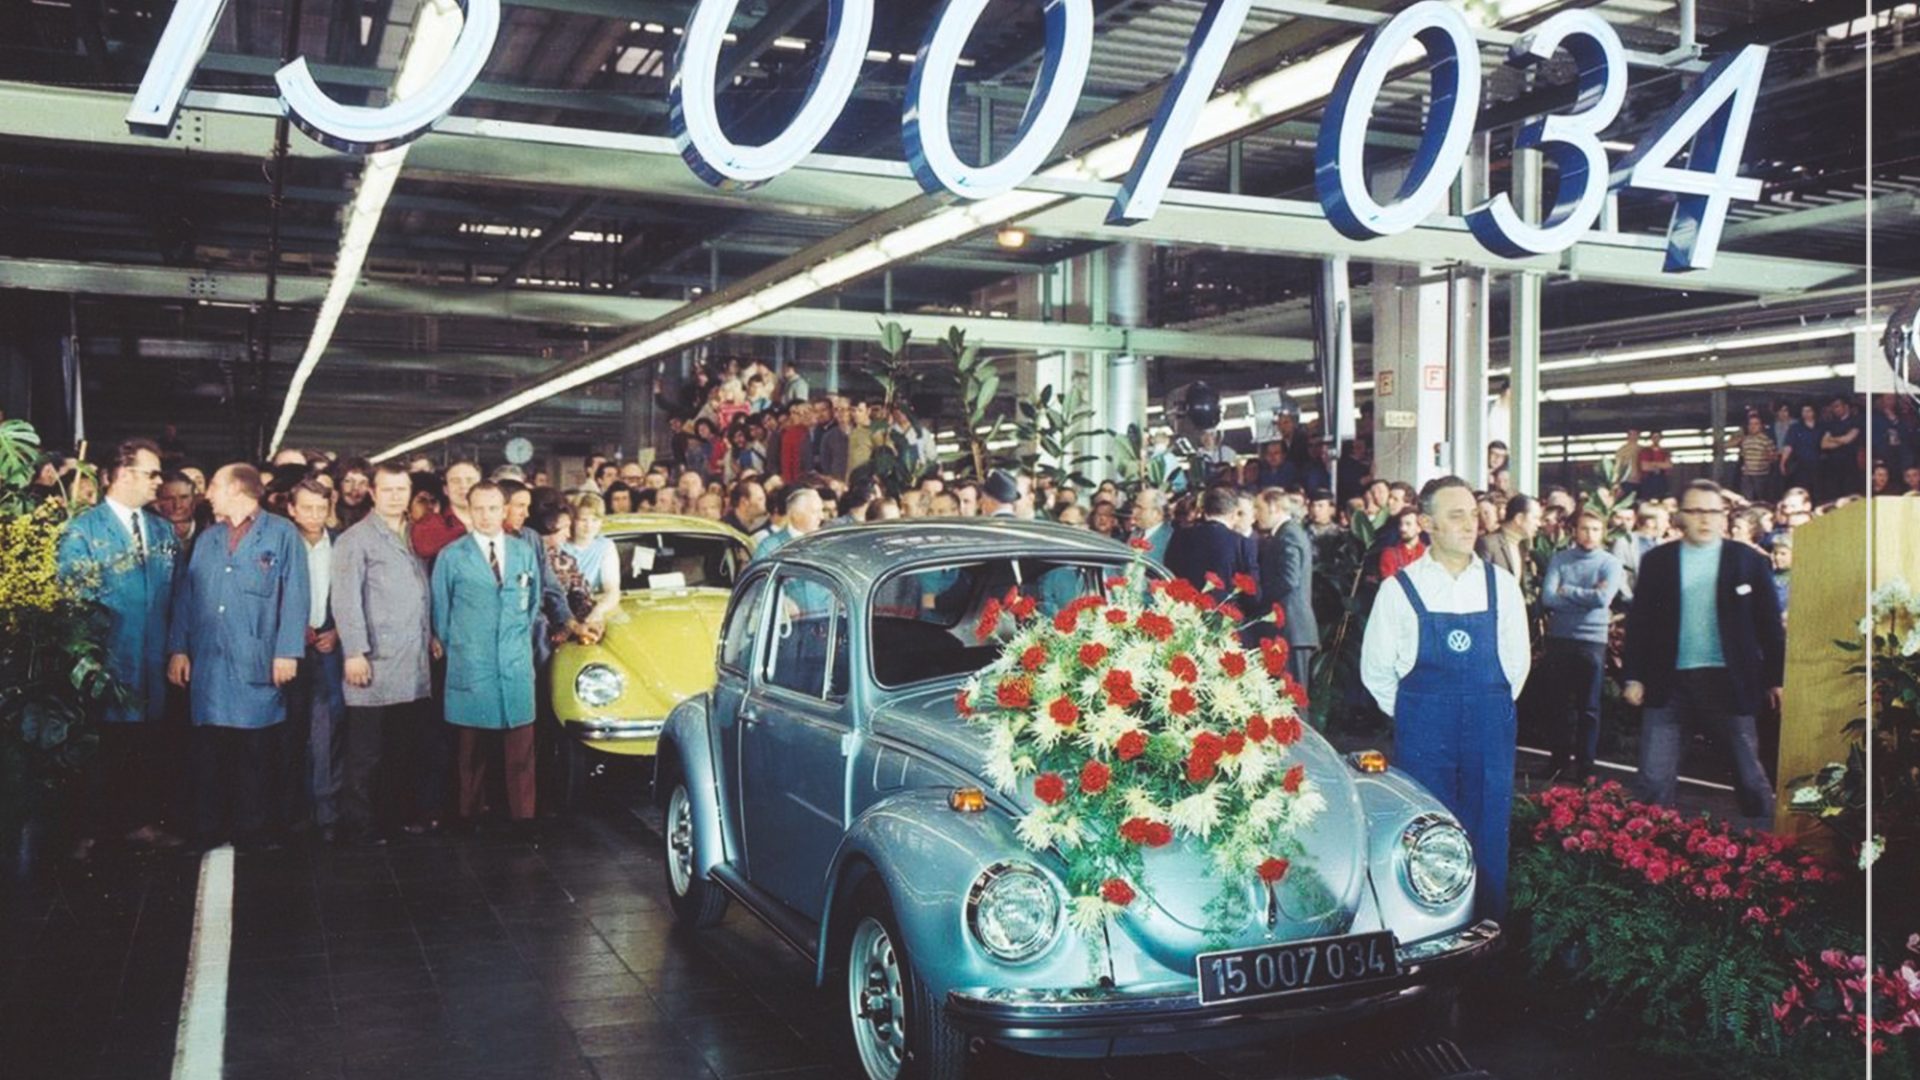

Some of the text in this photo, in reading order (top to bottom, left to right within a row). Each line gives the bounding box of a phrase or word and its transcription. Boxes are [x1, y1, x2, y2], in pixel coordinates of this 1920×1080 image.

[1316, 0, 1769, 272] 034
[1448, 630, 1471, 652] VW
[1211, 938, 1386, 996] 15 007 034
